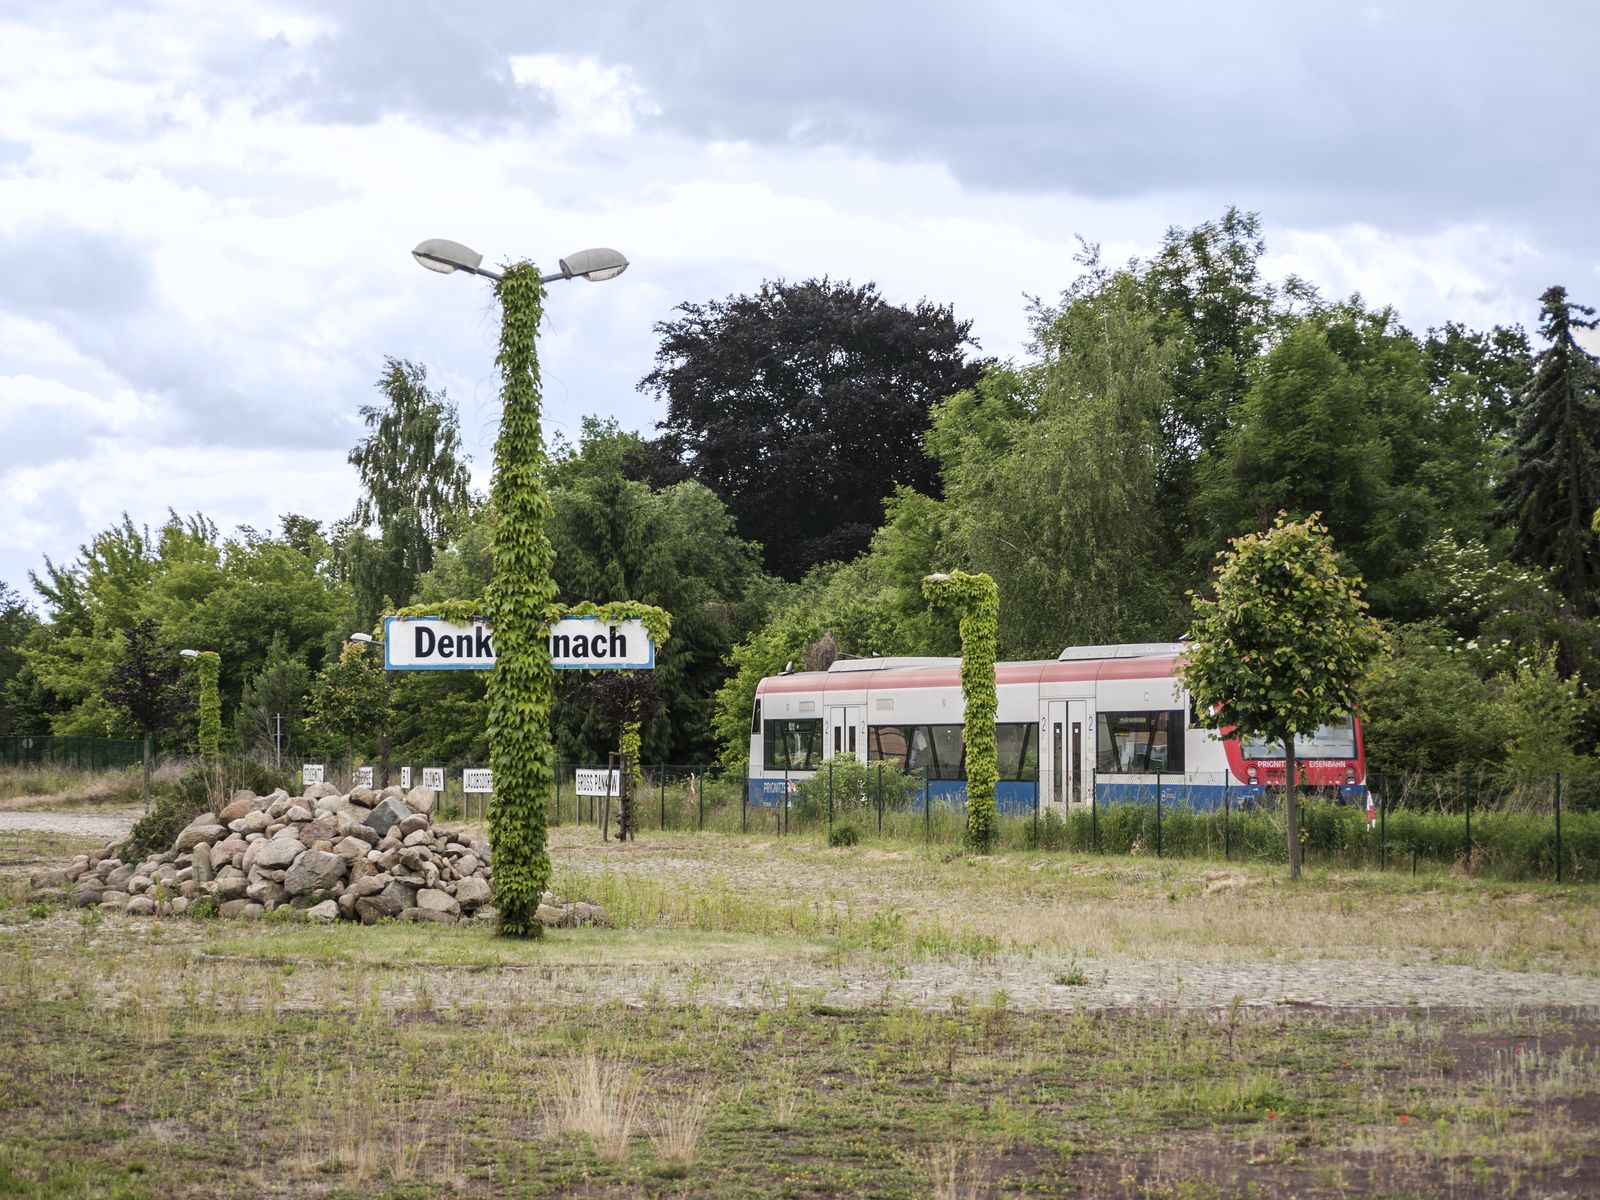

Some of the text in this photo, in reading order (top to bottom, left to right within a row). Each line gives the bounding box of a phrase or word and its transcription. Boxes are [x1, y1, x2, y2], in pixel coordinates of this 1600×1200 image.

[415, 626, 626, 658] Denknach
[1257, 760, 1346, 768] PRIGNITR EISENBAHN
